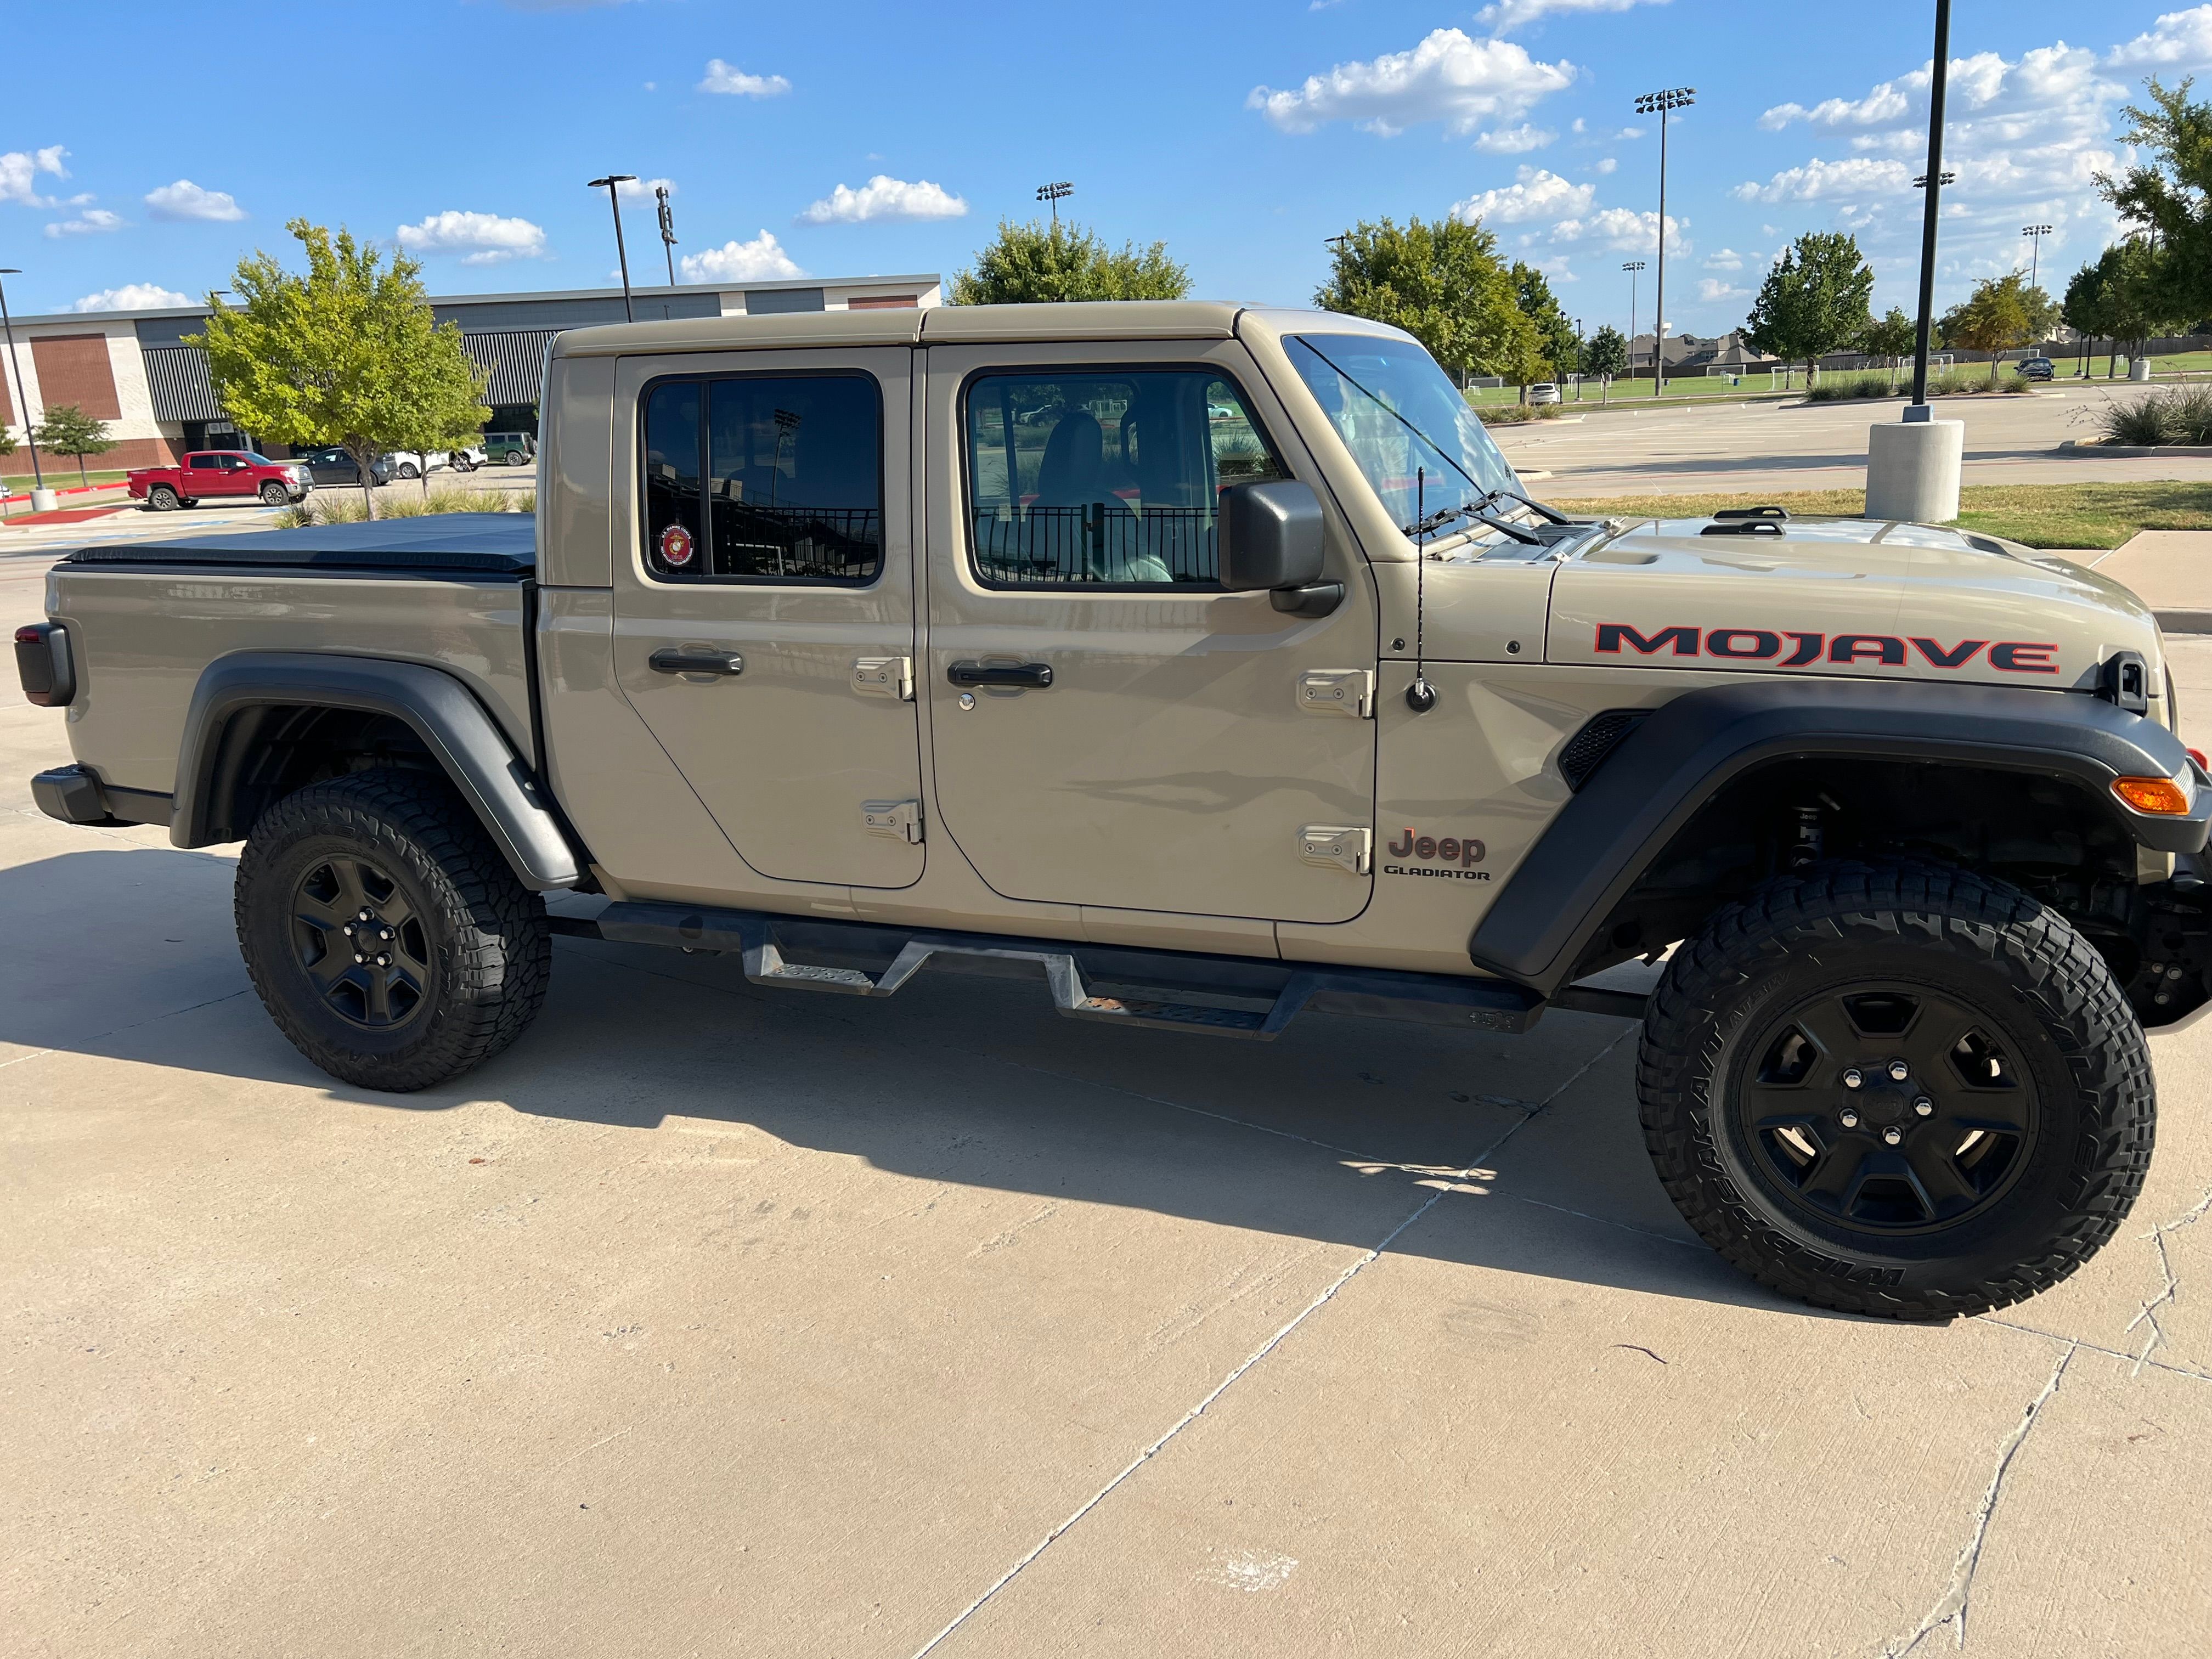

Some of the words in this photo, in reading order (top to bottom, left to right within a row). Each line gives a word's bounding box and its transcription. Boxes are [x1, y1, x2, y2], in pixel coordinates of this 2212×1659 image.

[681, 527, 691, 539] CORPS
[1594, 623, 2059, 674] MOJAVE
[1389, 827, 1486, 867] Jeep
[1384, 865, 1491, 881] GLADIATOR
